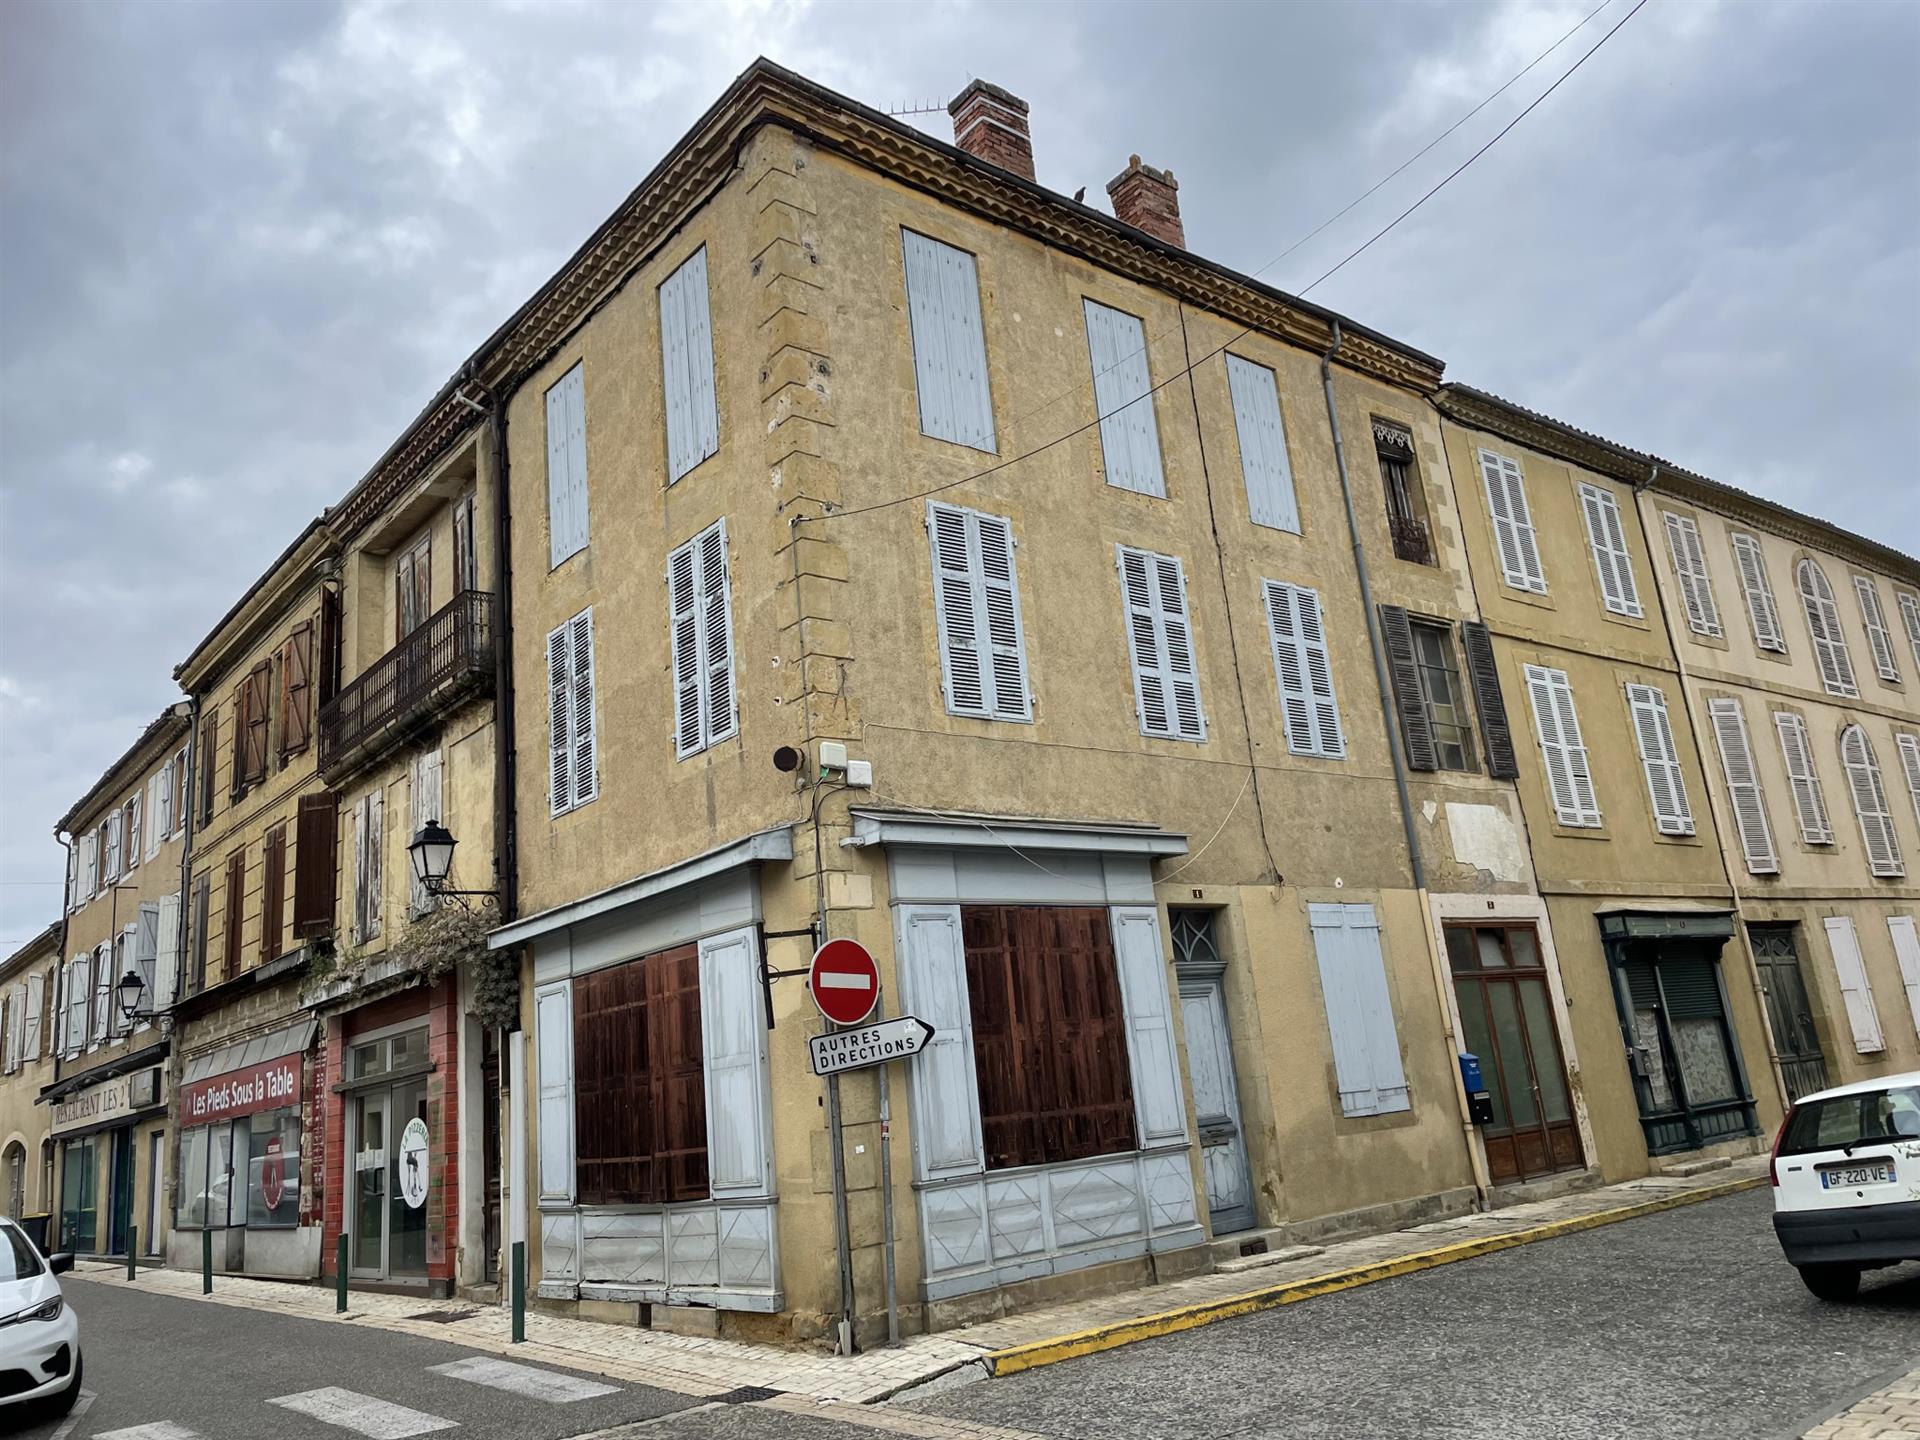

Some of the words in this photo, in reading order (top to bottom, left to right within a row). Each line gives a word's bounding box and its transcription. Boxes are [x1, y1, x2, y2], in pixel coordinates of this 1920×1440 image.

[819, 1030, 881, 1054] AUTRES
[820, 1037, 915, 1068] DIRECTIONS
[55, 1092, 101, 1125] RESTAURANT
[103, 1087, 118, 1112] LES
[192, 1092, 206, 1116] Les
[207, 1082, 230, 1112] Pieds
[231, 1081, 253, 1107] Sous
[255, 1073, 264, 1101] la
[266, 1065, 294, 1098] Table
[1829, 1167, 1886, 1185] GF-220-VE
